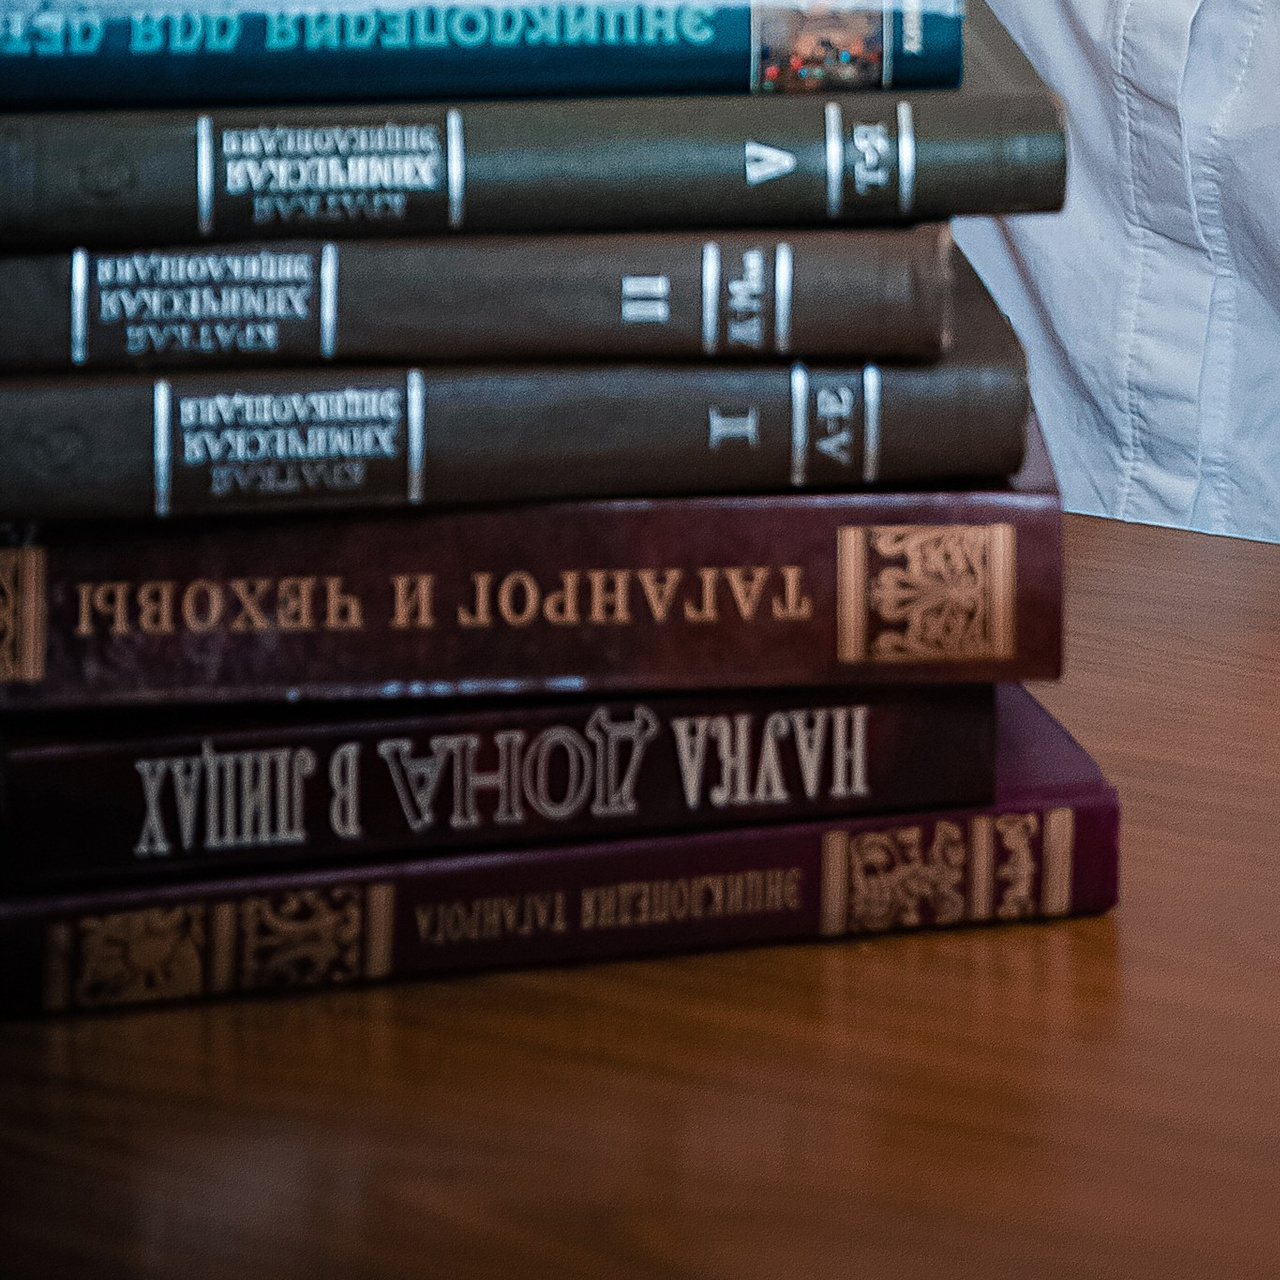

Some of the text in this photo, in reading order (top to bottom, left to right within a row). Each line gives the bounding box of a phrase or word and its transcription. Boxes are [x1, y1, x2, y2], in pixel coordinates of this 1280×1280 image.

[129, 12, 240, 56] ДЛЯ
[264, 2, 716, 53] ЭНЦИКЛОПЕДИЯ
[222, 124, 440, 156] ЭНЦИКЛОПЕДИЯ
[225, 154, 440, 195] ХИМИЧЕСКАЯ
[745, 140, 798, 188] V
[97, 251, 314, 284] ЭНЦИКЛОПЕДИЯ
[100, 286, 312, 322] ХИМИЧЕСКАЯ
[621, 275, 671, 324] II
[180, 389, 402, 428] ЭНЦИКЛОПЕДИЯ
[708, 406, 758, 450] I
[183, 424, 401, 465] ХИМИЧЕСКАЯ
[75, 564, 814, 637] ТАГАНРОГ И ЧЕХОВЫ
[133, 704, 870, 858] НАУКА ДОНА В ЛИЦАХ
[415, 867, 804, 945] ЭНЦИКЛОПЕДИЯ ТАГАНРОГА
